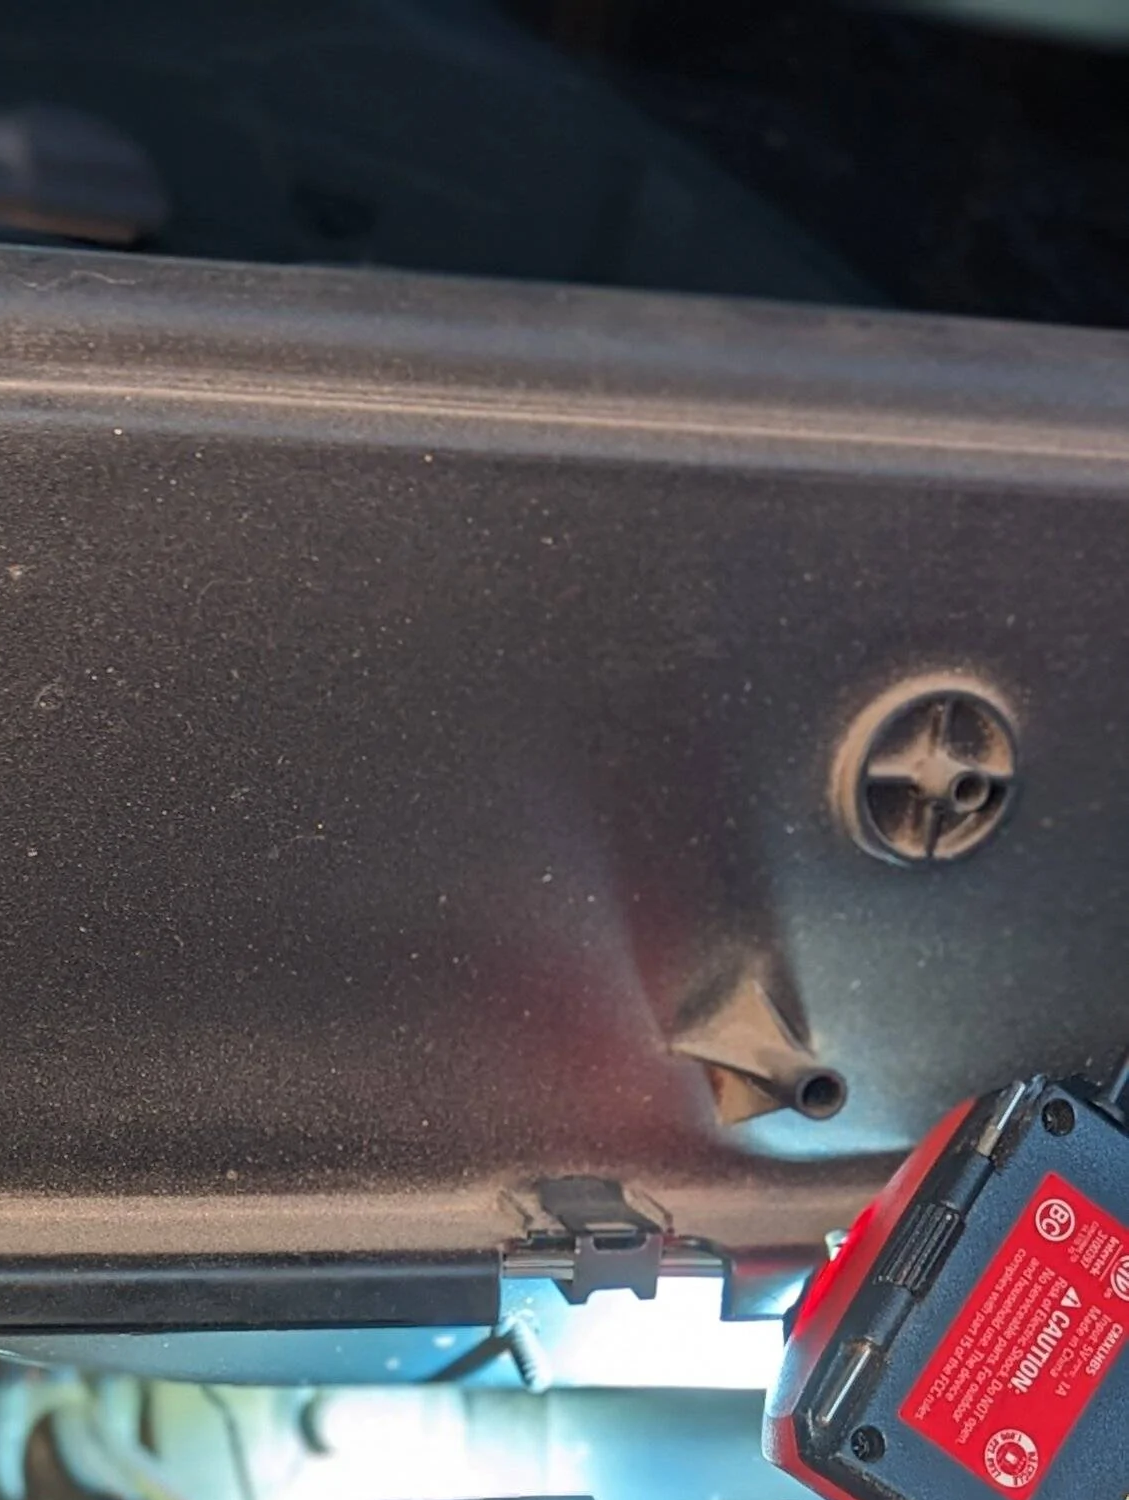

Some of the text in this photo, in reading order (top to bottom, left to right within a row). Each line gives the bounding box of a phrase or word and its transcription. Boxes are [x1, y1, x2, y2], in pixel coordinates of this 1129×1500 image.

[1041, 1204, 1070, 1237] BC
[1089, 1236, 1120, 1275] Intertek
[995, 1248, 1026, 1292] complies
[1023, 1257, 1040, 1280] and
[1038, 1267, 1056, 1284] No
[1047, 1276, 1068, 1298] Risk
[981, 1291, 999, 1314] with
[991, 1276, 1029, 1330] household
[1003, 1283, 1042, 1339] serviceable
[1041, 1298, 1052, 1312] of
[968, 1311, 985, 1336] part
[1017, 1308, 1047, 1346] Electric
[954, 1346, 964, 1361] of
[960, 1335, 974, 1348] 15
[1008, 1310, 1070, 1393] CAUTION:
[1049, 1305, 1101, 1378] Made in China
[942, 1357, 959, 1375] the
[965, 1349, 985, 1369] The
[930, 1373, 950, 1398] FCC
[945, 1367, 970, 1401] device
[976, 1366, 992, 1385] For
[986, 1378, 1003, 1396] Do
[952, 1383, 979, 1423] outdoor
[973, 1394, 994, 1421] NOT
